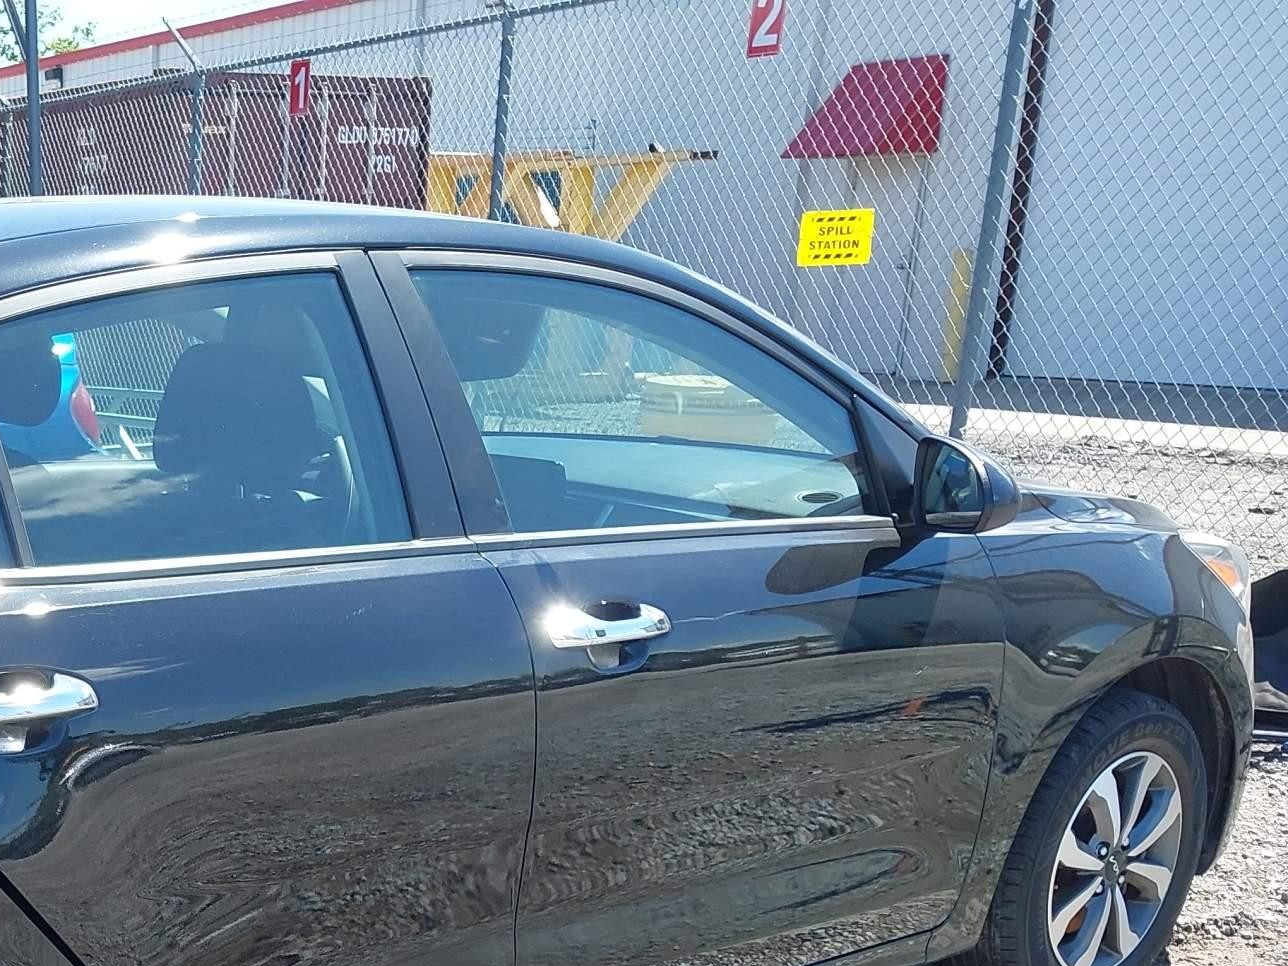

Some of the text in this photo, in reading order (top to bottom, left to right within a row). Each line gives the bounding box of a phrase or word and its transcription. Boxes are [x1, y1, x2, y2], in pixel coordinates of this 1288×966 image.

[752, 0, 781, 47] 2
[294, 67, 306, 109] 1
[818, 225, 852, 236] SPILL
[809, 240, 860, 251] STATION
